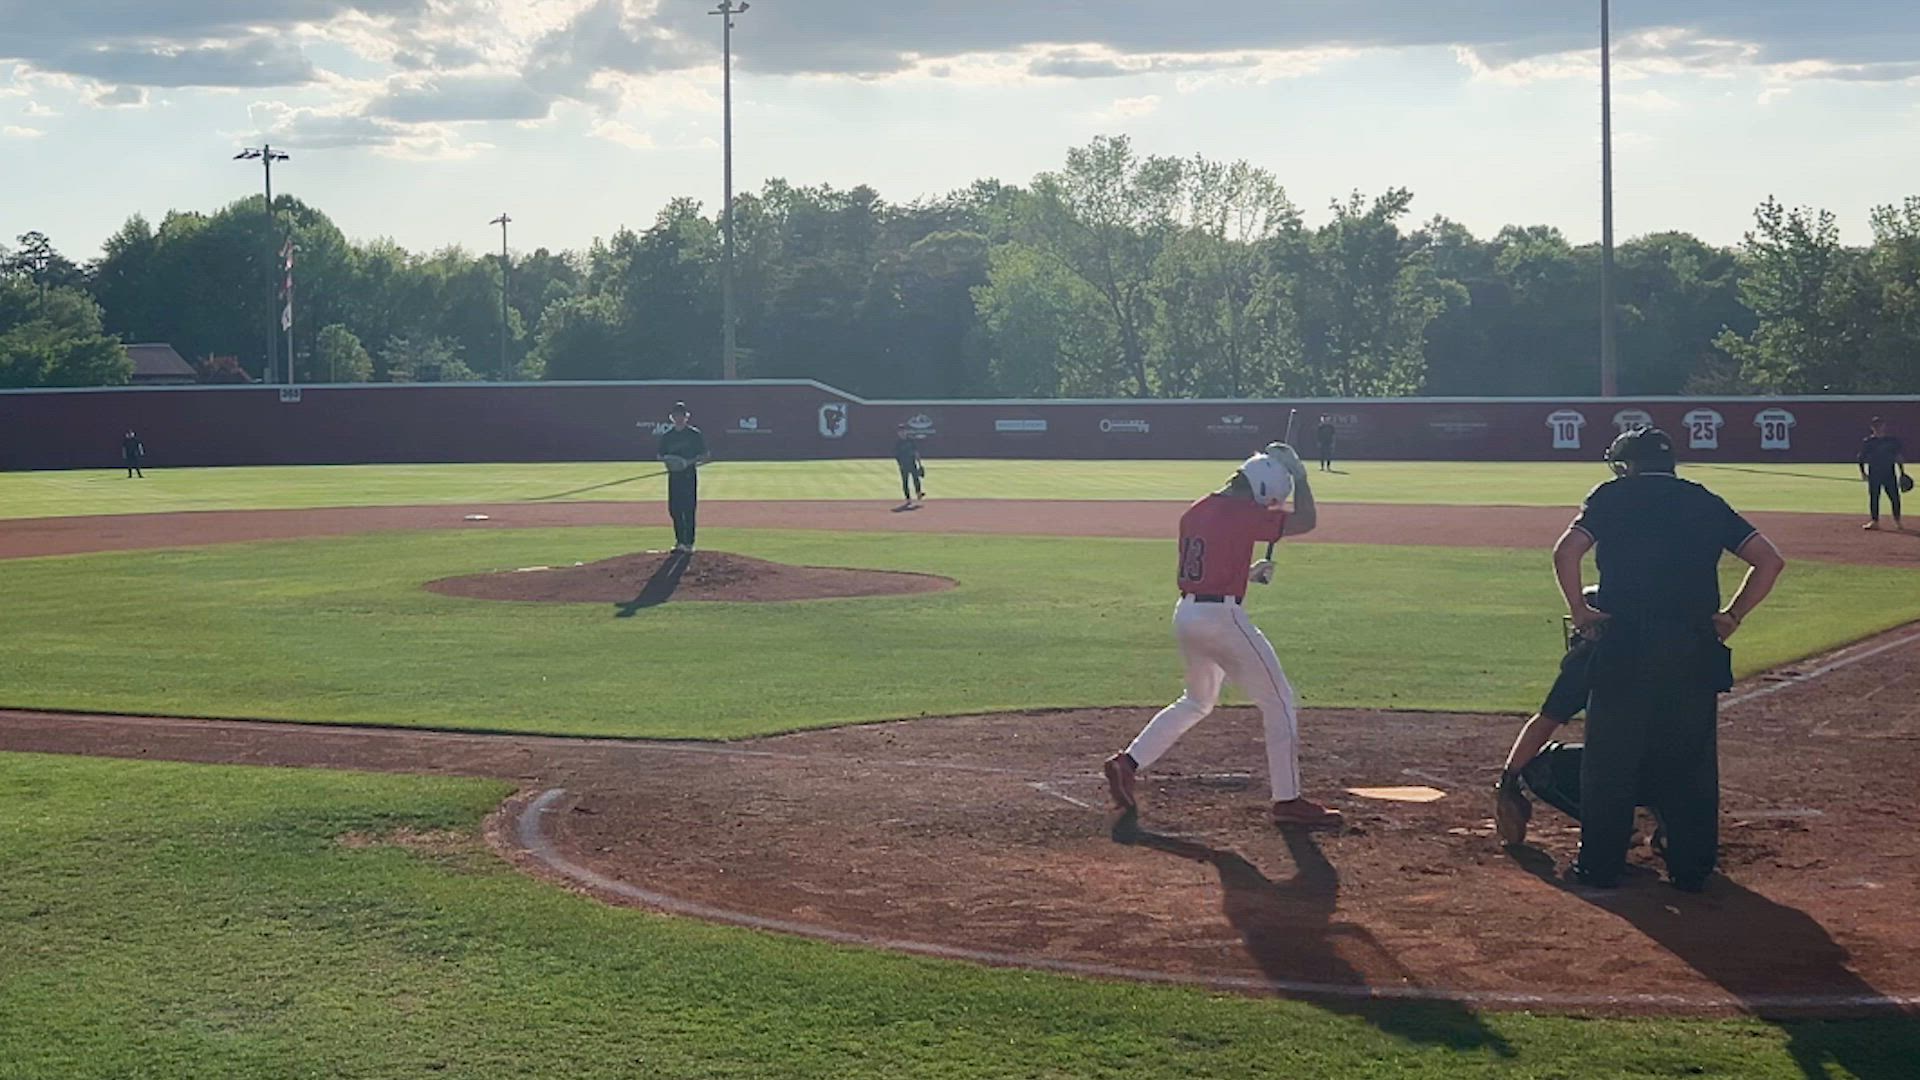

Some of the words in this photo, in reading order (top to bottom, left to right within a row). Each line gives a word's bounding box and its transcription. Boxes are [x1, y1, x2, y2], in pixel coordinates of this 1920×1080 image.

[1559, 422, 1575, 441] 10
[1693, 422, 1713, 441] 25
[1765, 422, 1786, 441] 30
[1179, 537, 1205, 582] 13
